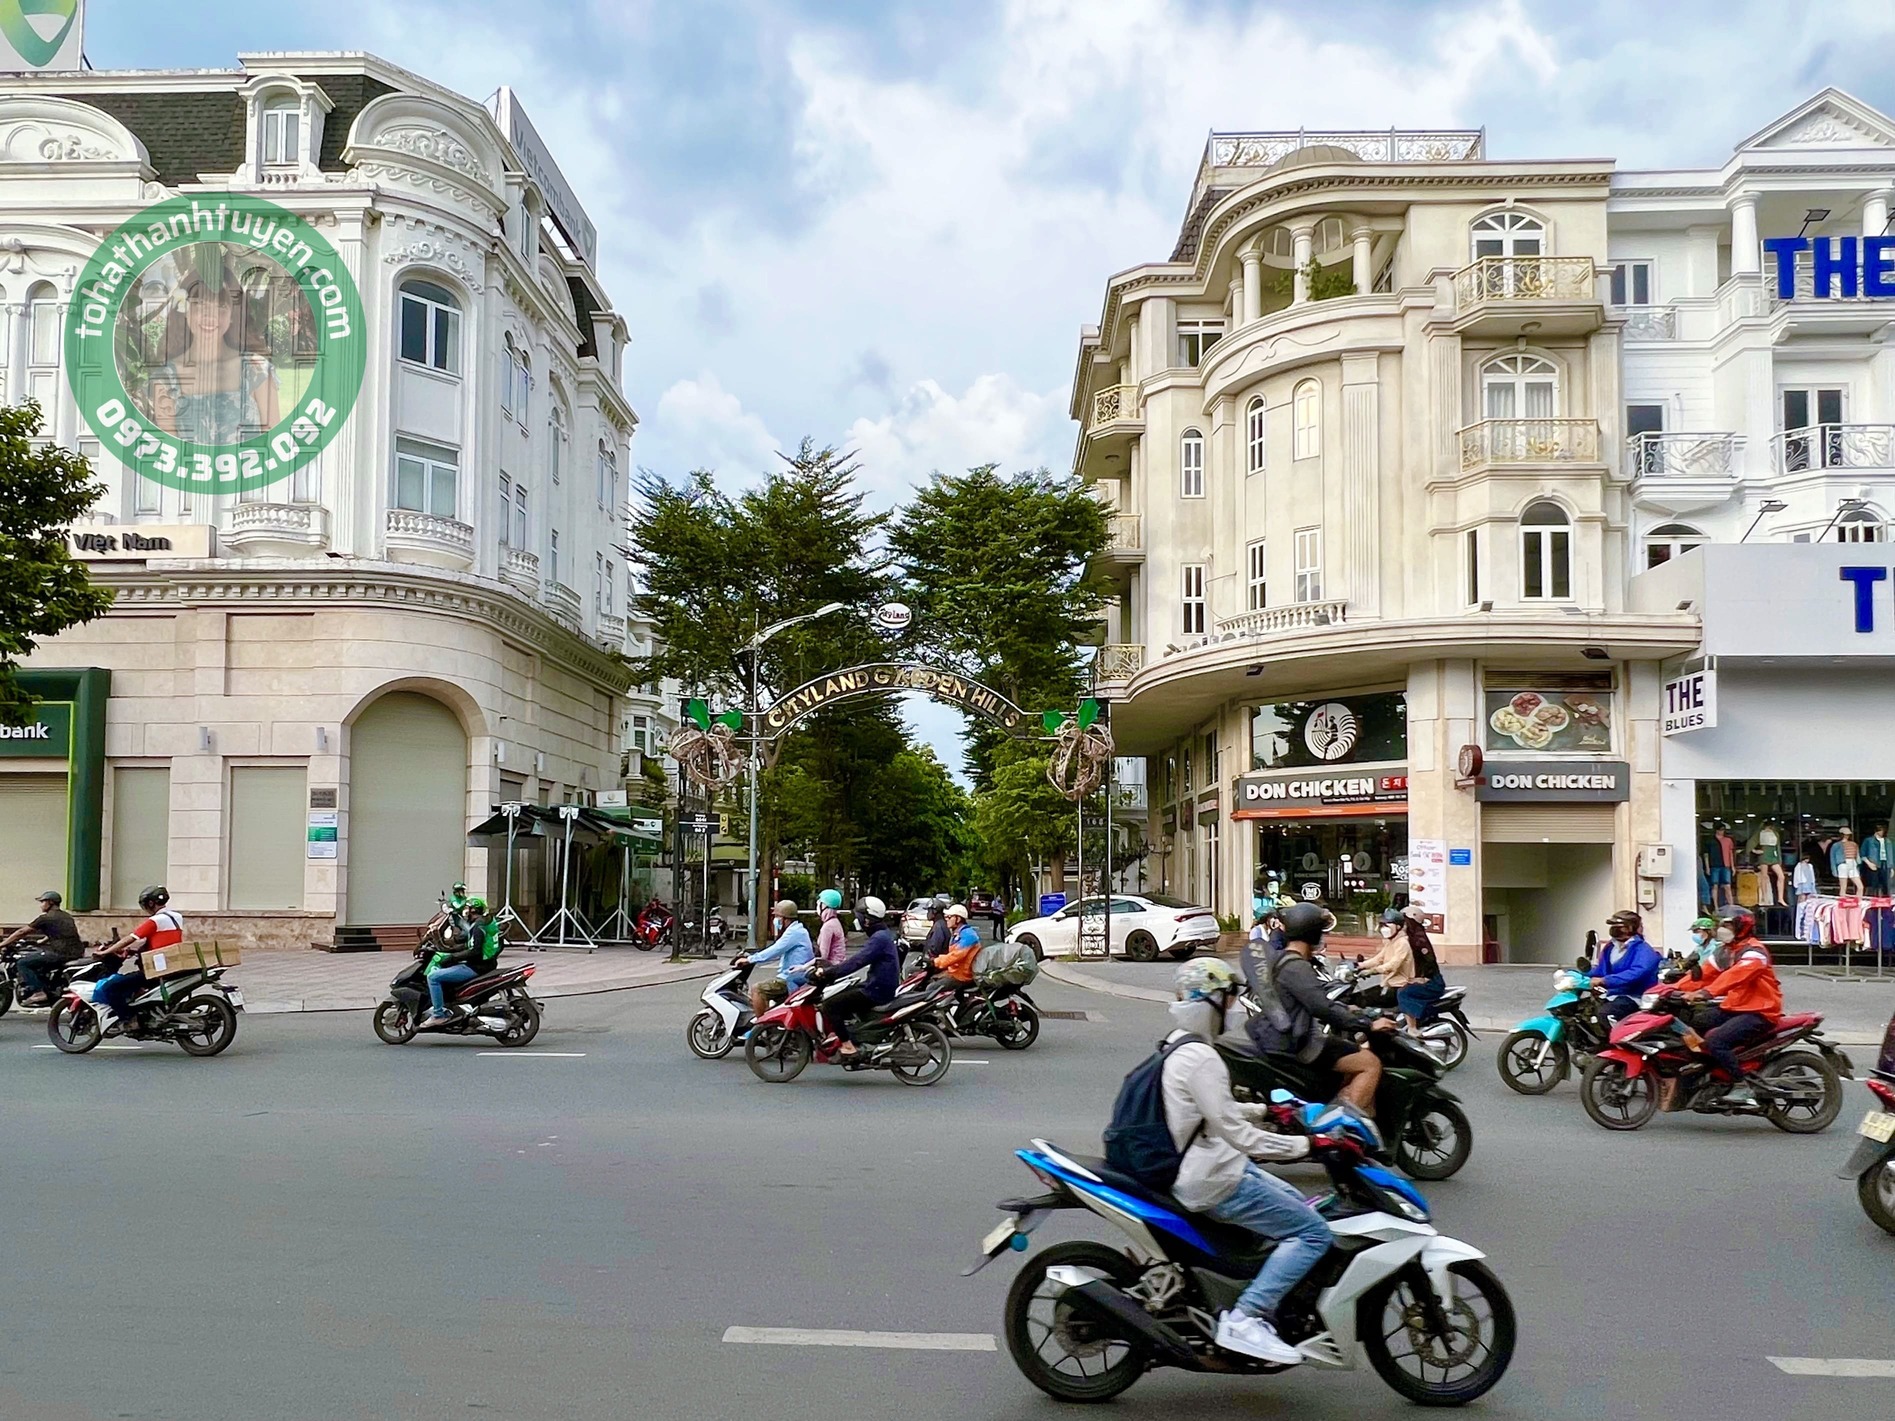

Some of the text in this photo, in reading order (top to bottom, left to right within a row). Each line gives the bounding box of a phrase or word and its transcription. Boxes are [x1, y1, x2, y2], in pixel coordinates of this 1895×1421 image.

[514, 119, 581, 243] Vietcombank
[1763, 236, 1895, 299] THE
[122, 533, 172, 551] Nam
[768, 668, 1020, 728] CITYLAND GARDEN HILLS
[1665, 675, 1704, 714] THE
[1665, 713, 1704, 731] BLUES
[1246, 778, 1375, 800] DON CHICKEN
[1491, 774, 1615, 789] DON CHICKEN
